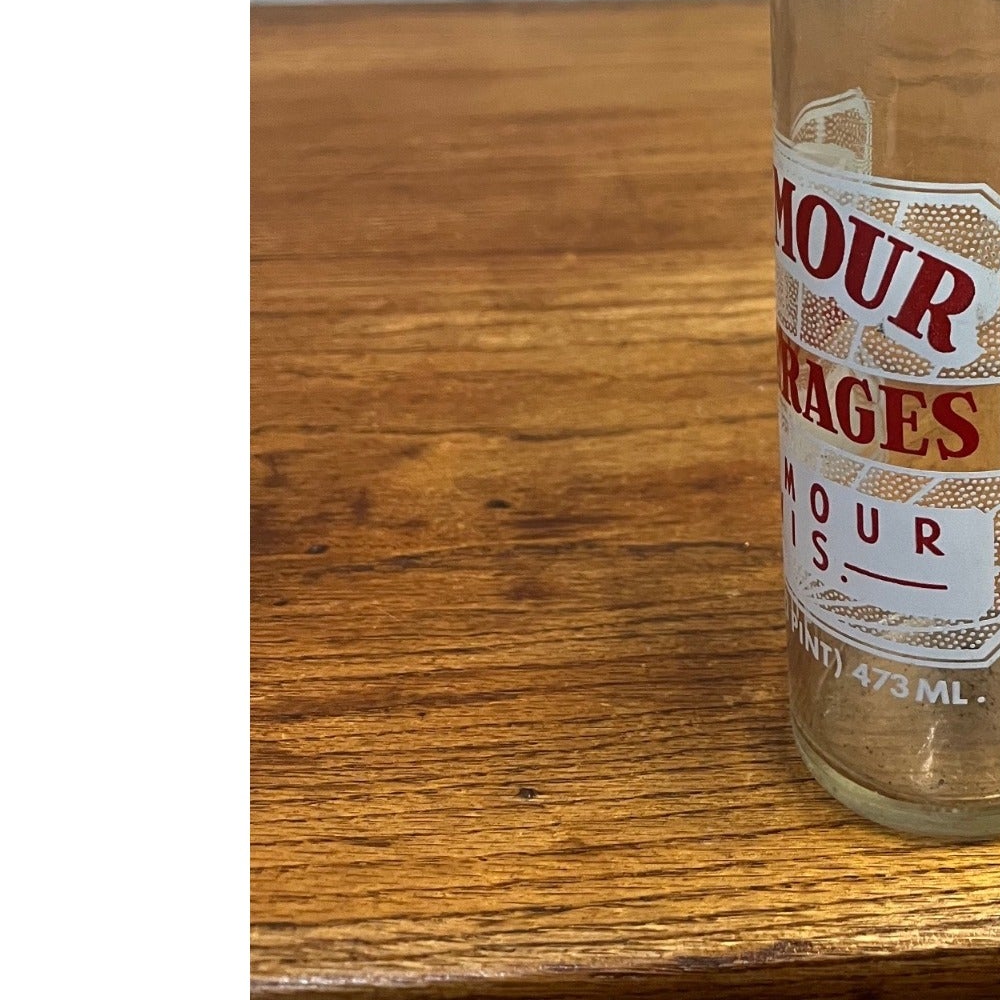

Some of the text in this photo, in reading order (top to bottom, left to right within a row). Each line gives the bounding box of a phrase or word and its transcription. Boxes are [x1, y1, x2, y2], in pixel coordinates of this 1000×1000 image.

[773, 163, 976, 354] MOUR
[778, 324, 980, 461] RAGES
[784, 455, 945, 556] MOUR
[852, 663, 910, 698] 473
